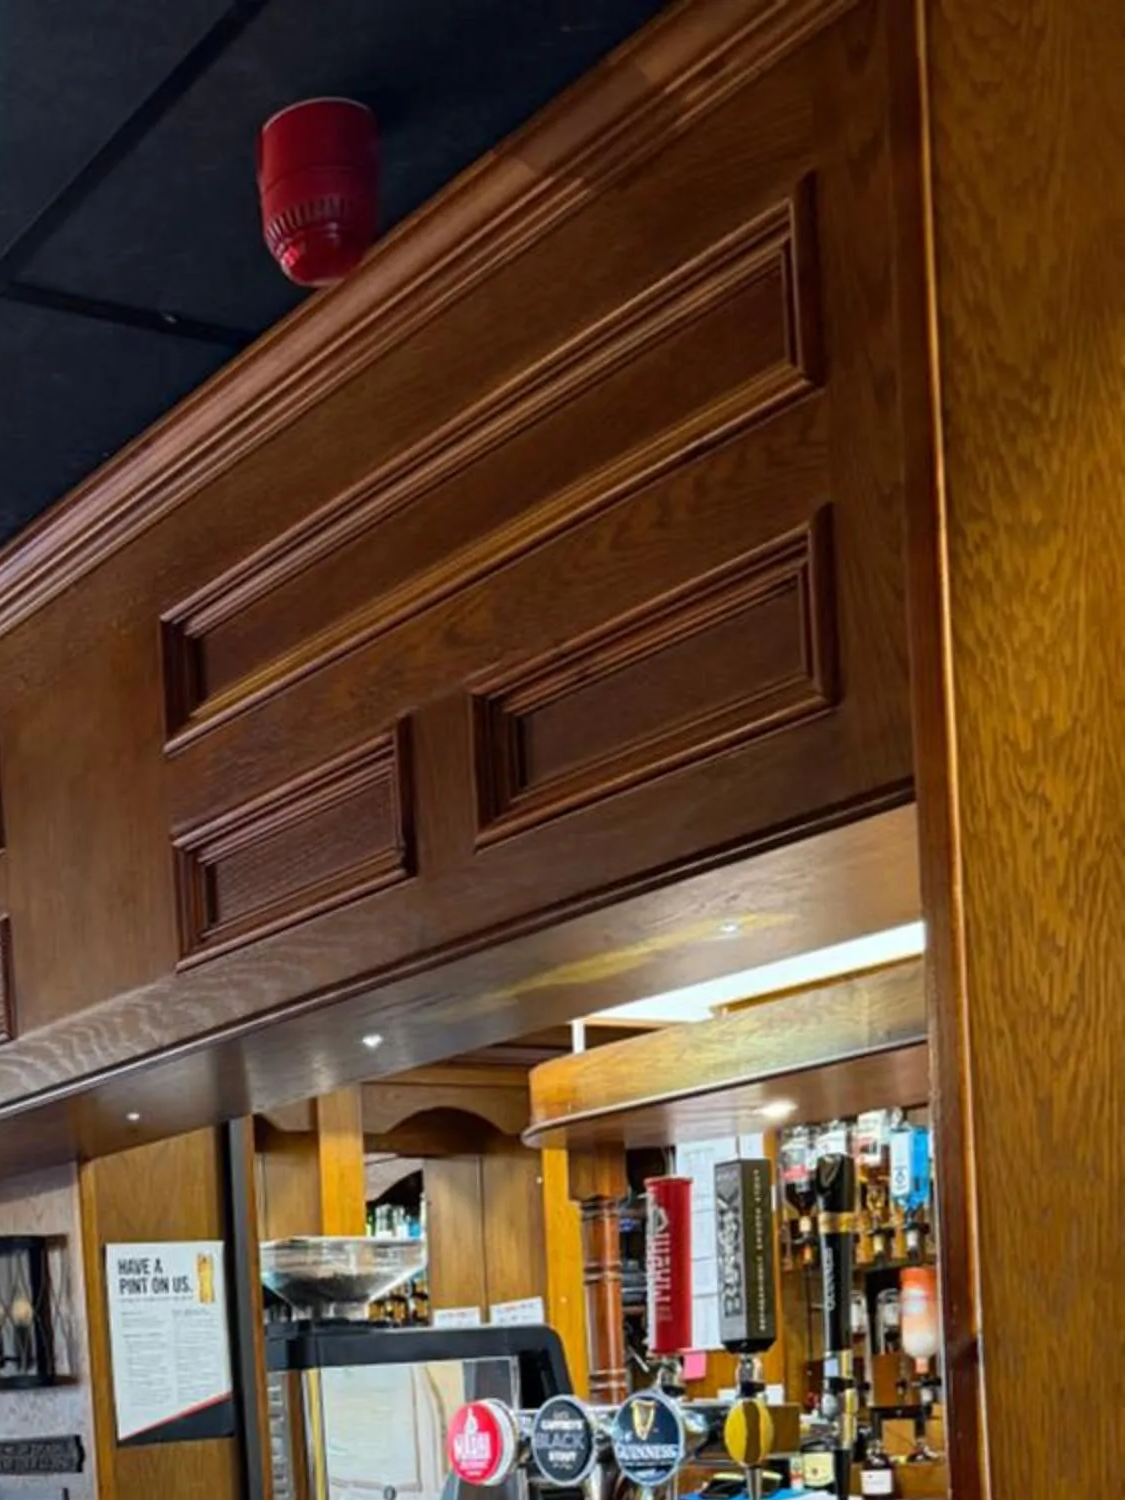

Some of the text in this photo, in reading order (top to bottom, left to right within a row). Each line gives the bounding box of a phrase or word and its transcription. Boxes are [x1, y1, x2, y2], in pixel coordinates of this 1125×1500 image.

[717, 1190, 743, 1317] BLACK
[117, 1257, 163, 1275] HAVE A
[119, 1276, 193, 1295] PINT ON US.
[536, 1433, 586, 1450] BLACK
[616, 1443, 678, 1460] GUINNESS
